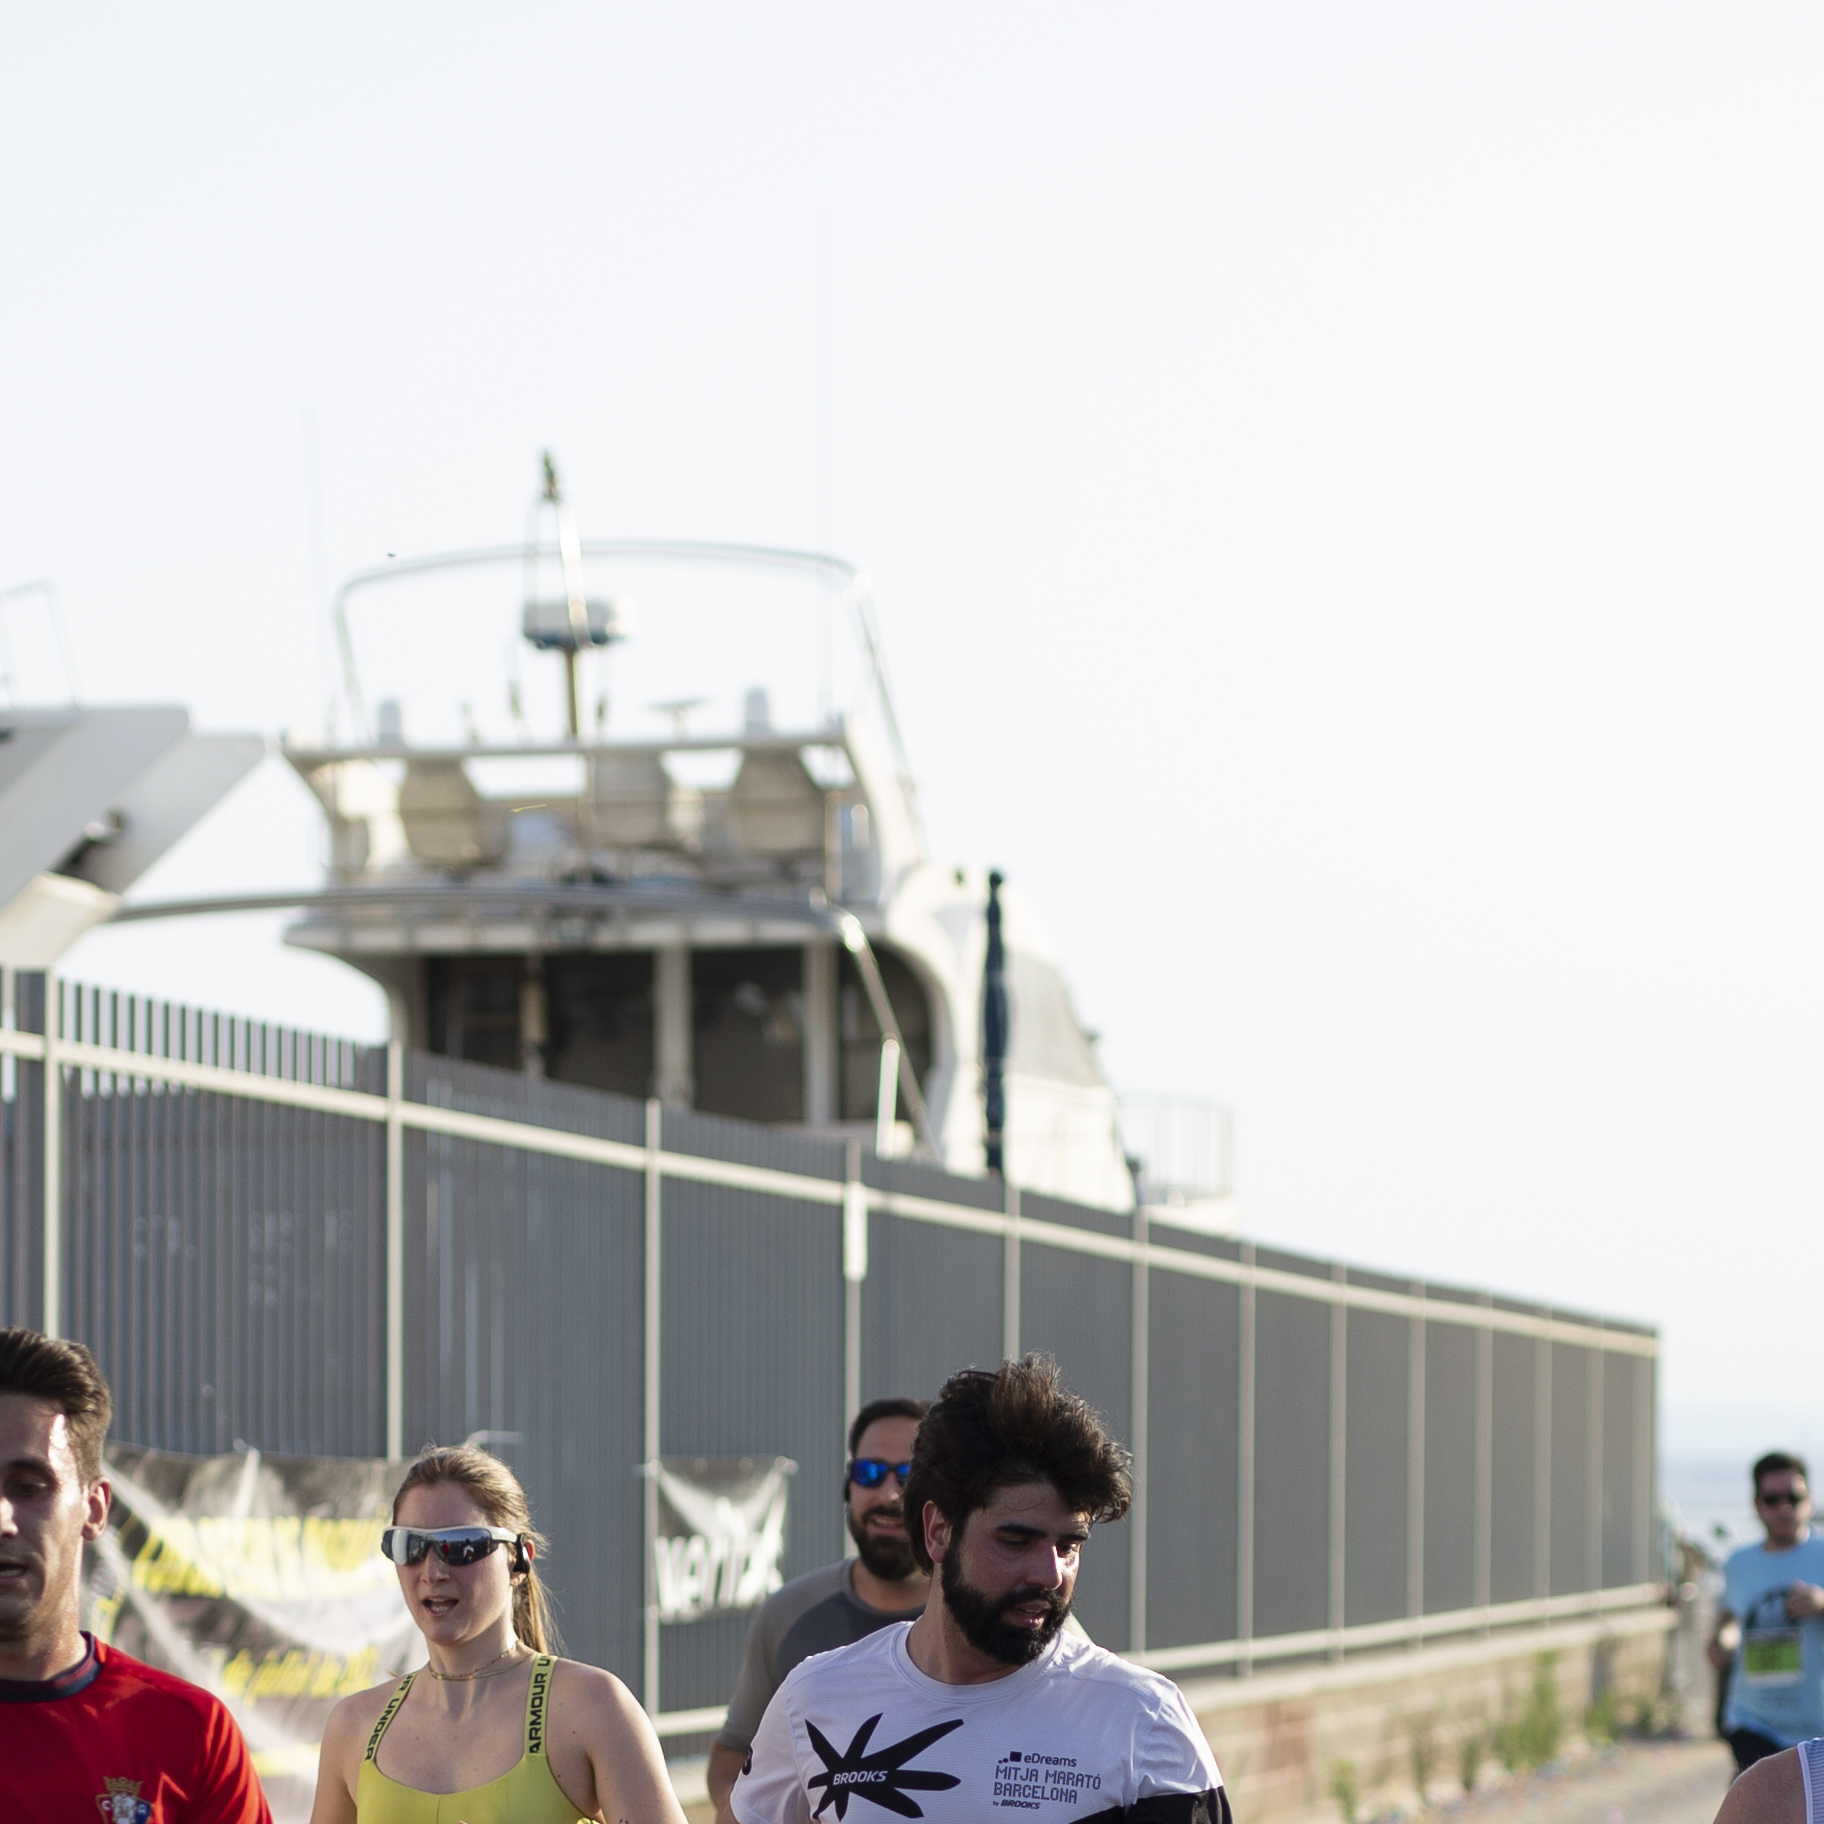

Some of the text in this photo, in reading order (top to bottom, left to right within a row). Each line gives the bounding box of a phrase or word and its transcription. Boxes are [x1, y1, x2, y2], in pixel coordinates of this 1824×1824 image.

[528, 1672, 548, 1754] ARMOUR
[365, 1697, 401, 1761] UNDER
[1024, 1752, 1077, 1767] eDreams
[832, 1770, 889, 1786] BROOKS
[995, 1765, 1101, 1790] MITJA MARATÓ
[993, 1781, 1078, 1804] BARCELONA
[1000, 1799, 1042, 1810] BROOKS
